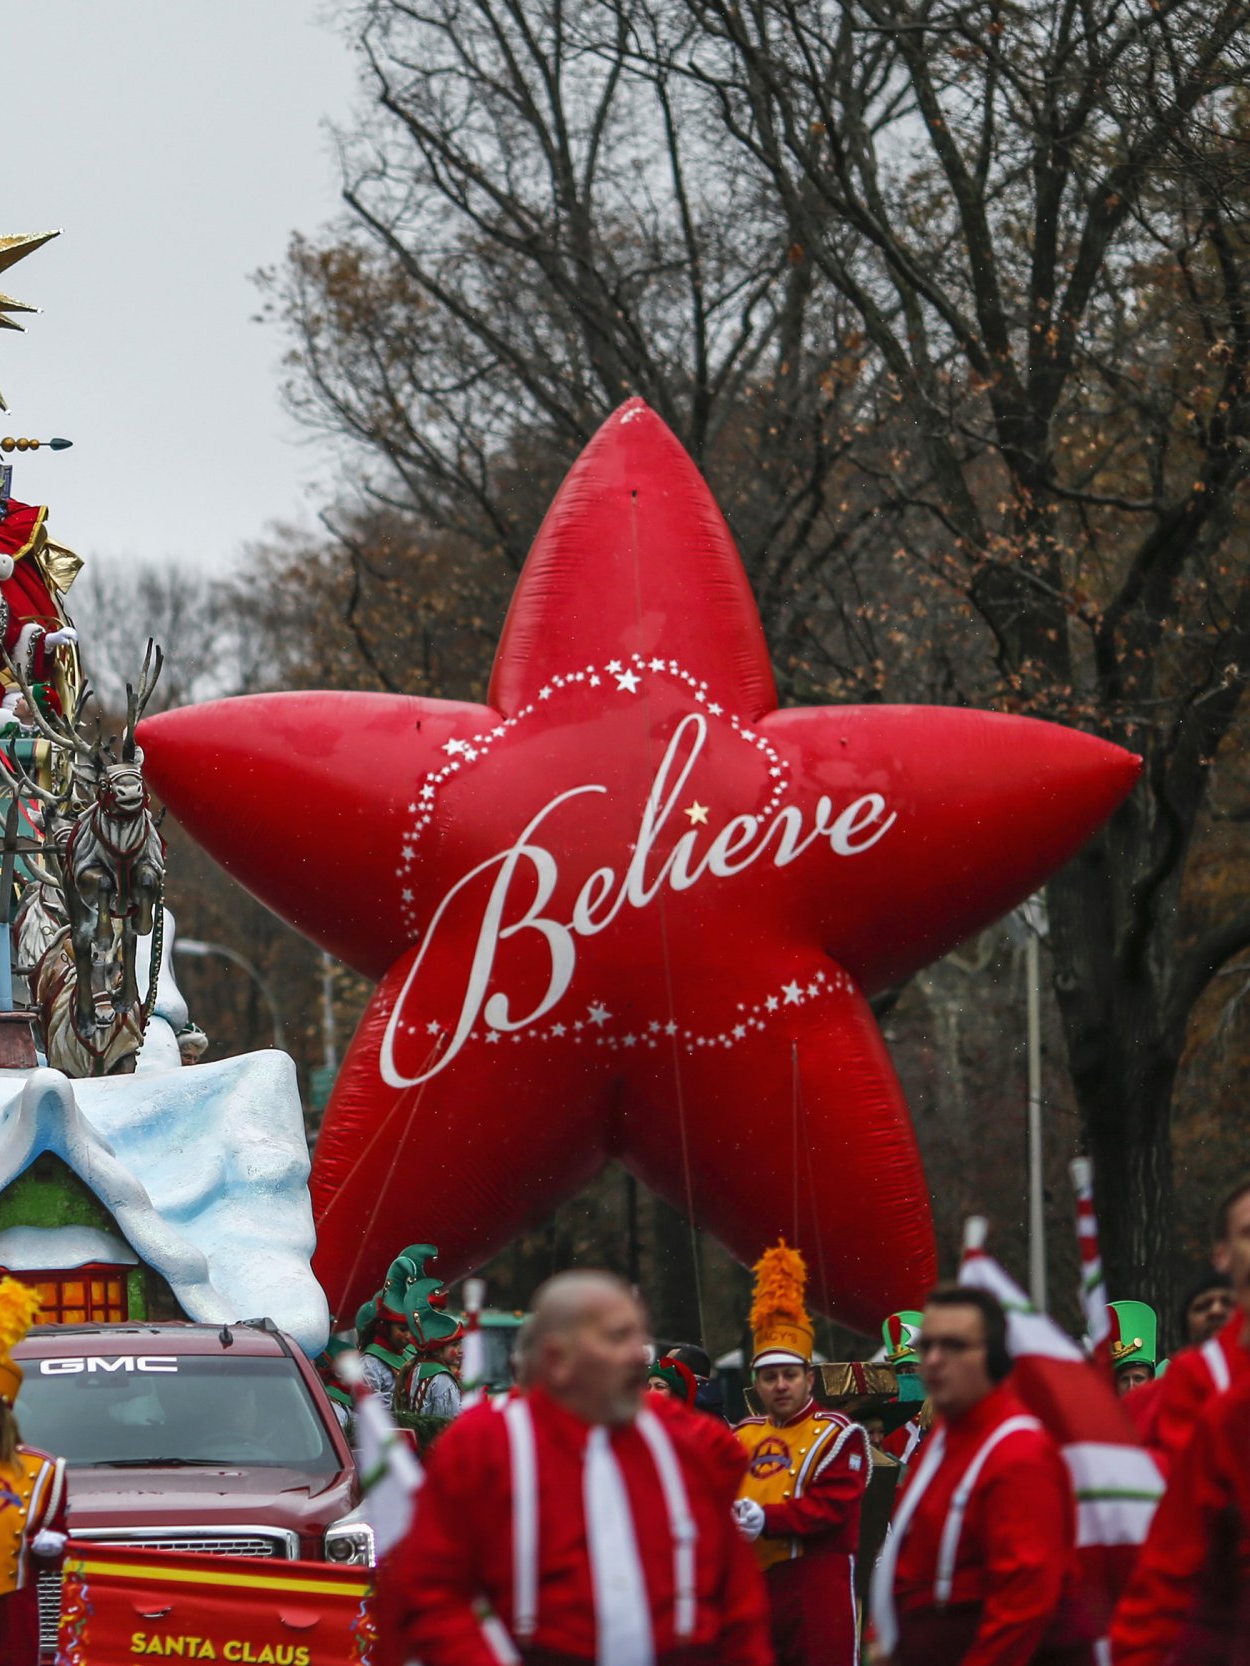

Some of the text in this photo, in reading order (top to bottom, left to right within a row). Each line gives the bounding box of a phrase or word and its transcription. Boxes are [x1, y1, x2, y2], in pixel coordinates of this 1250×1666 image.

[379, 713, 897, 1089] Believe
[40, 1356, 178, 1374] GMC
[130, 1632, 310, 1666] SANTA CLAUS
